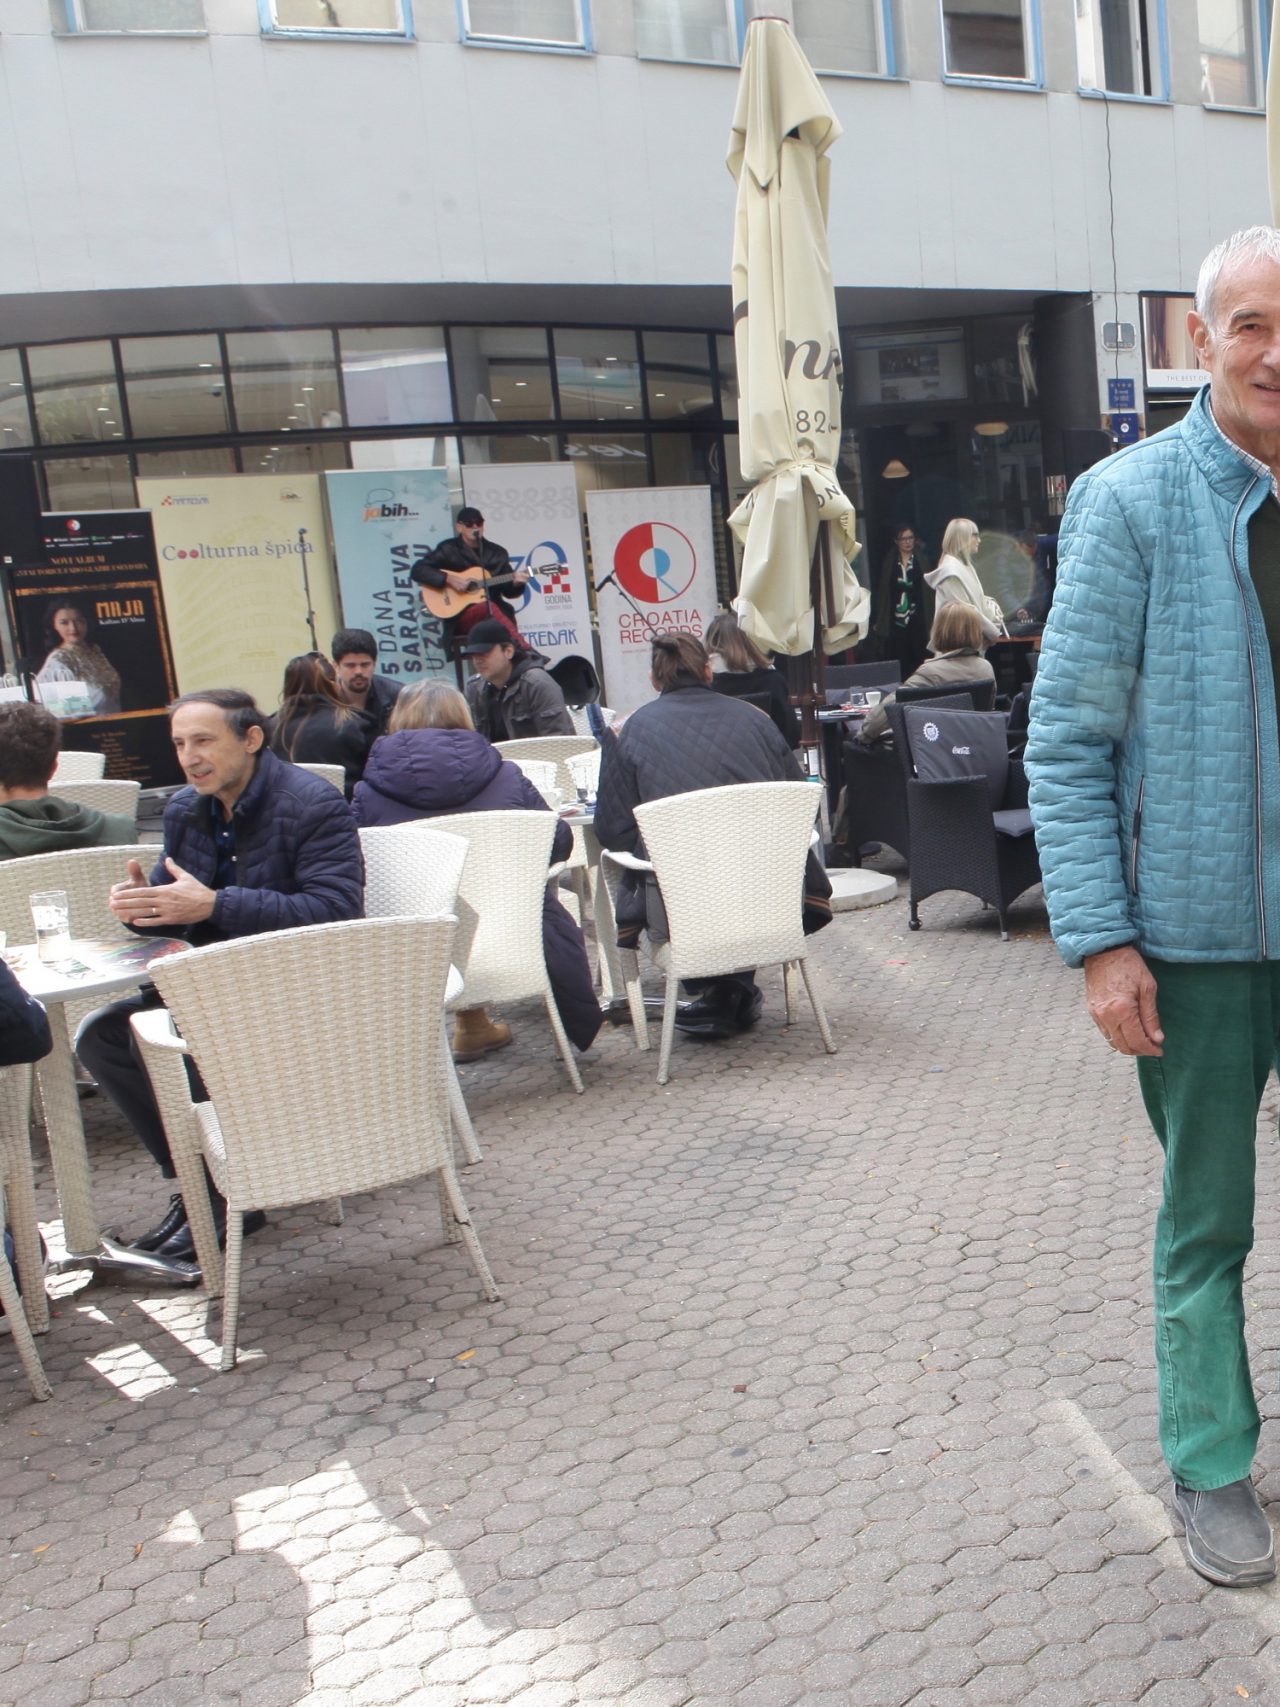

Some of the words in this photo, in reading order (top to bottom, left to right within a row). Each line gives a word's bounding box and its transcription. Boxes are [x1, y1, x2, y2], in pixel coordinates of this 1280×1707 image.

[390, 544, 422, 672] SARAJEVA
[373, 590, 397, 652] DANA
[619, 609, 702, 628] CROATIA
[521, 629, 578, 647] REDAK
[381, 662, 399, 674] 5
[426, 658, 444, 669] U
